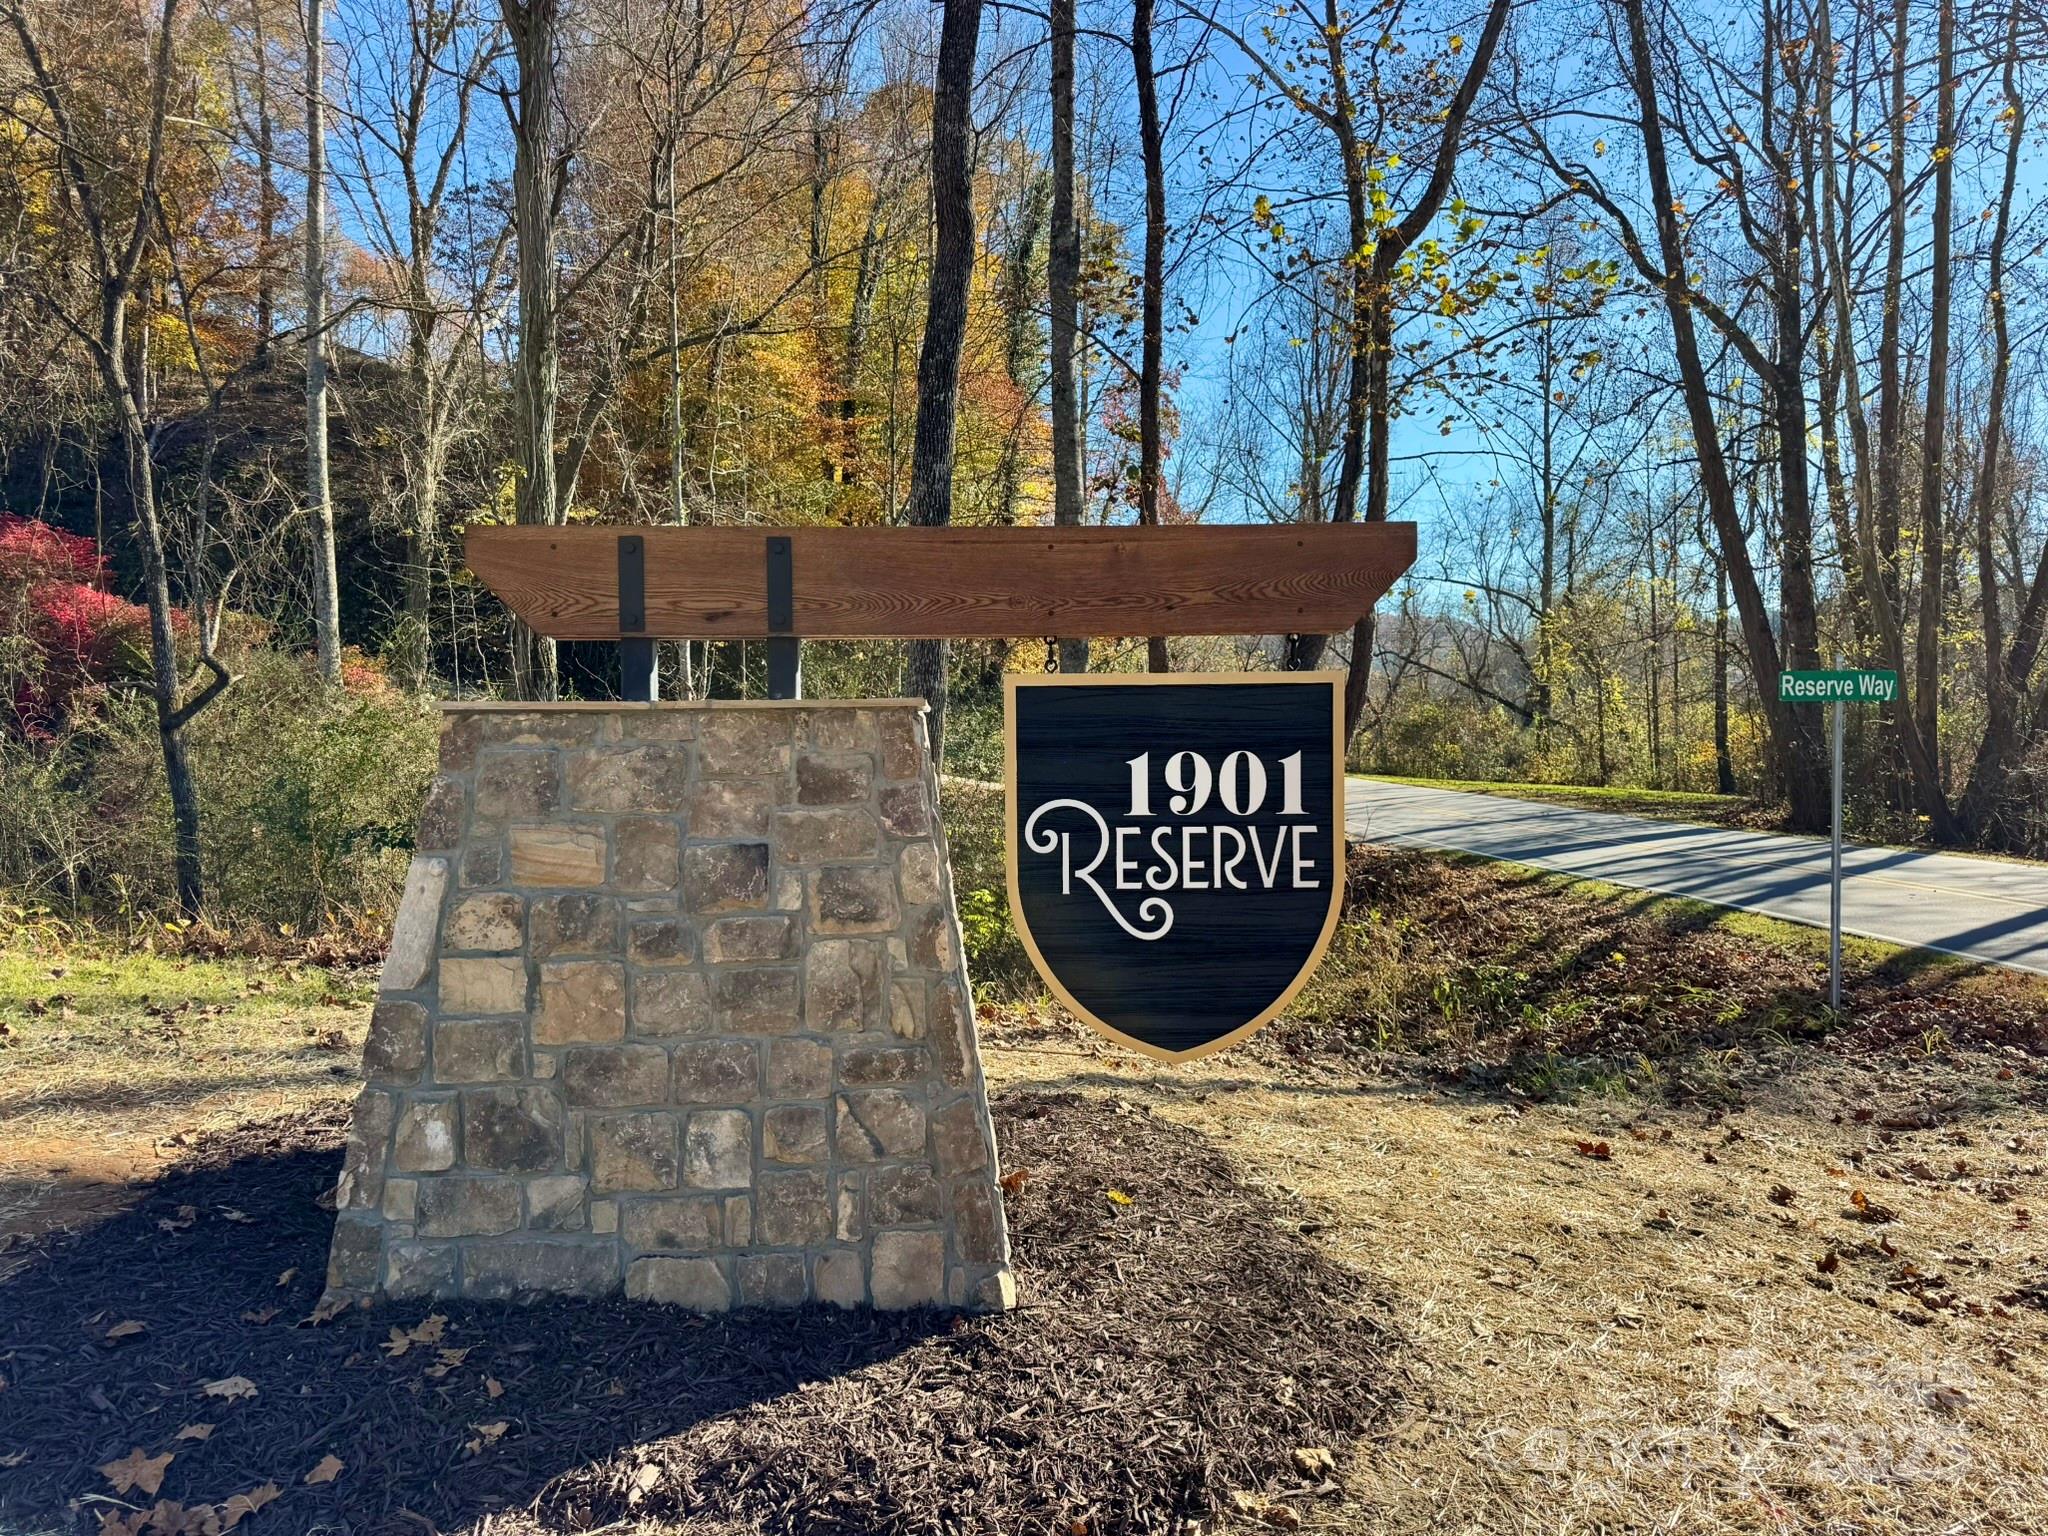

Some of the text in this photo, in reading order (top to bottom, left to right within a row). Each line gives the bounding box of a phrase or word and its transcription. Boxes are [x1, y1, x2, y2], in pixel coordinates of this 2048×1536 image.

[1781, 674, 1894, 700] Reserve Way
[1123, 750, 1309, 816] 1901
[1024, 798, 1320, 940] RESERVE
